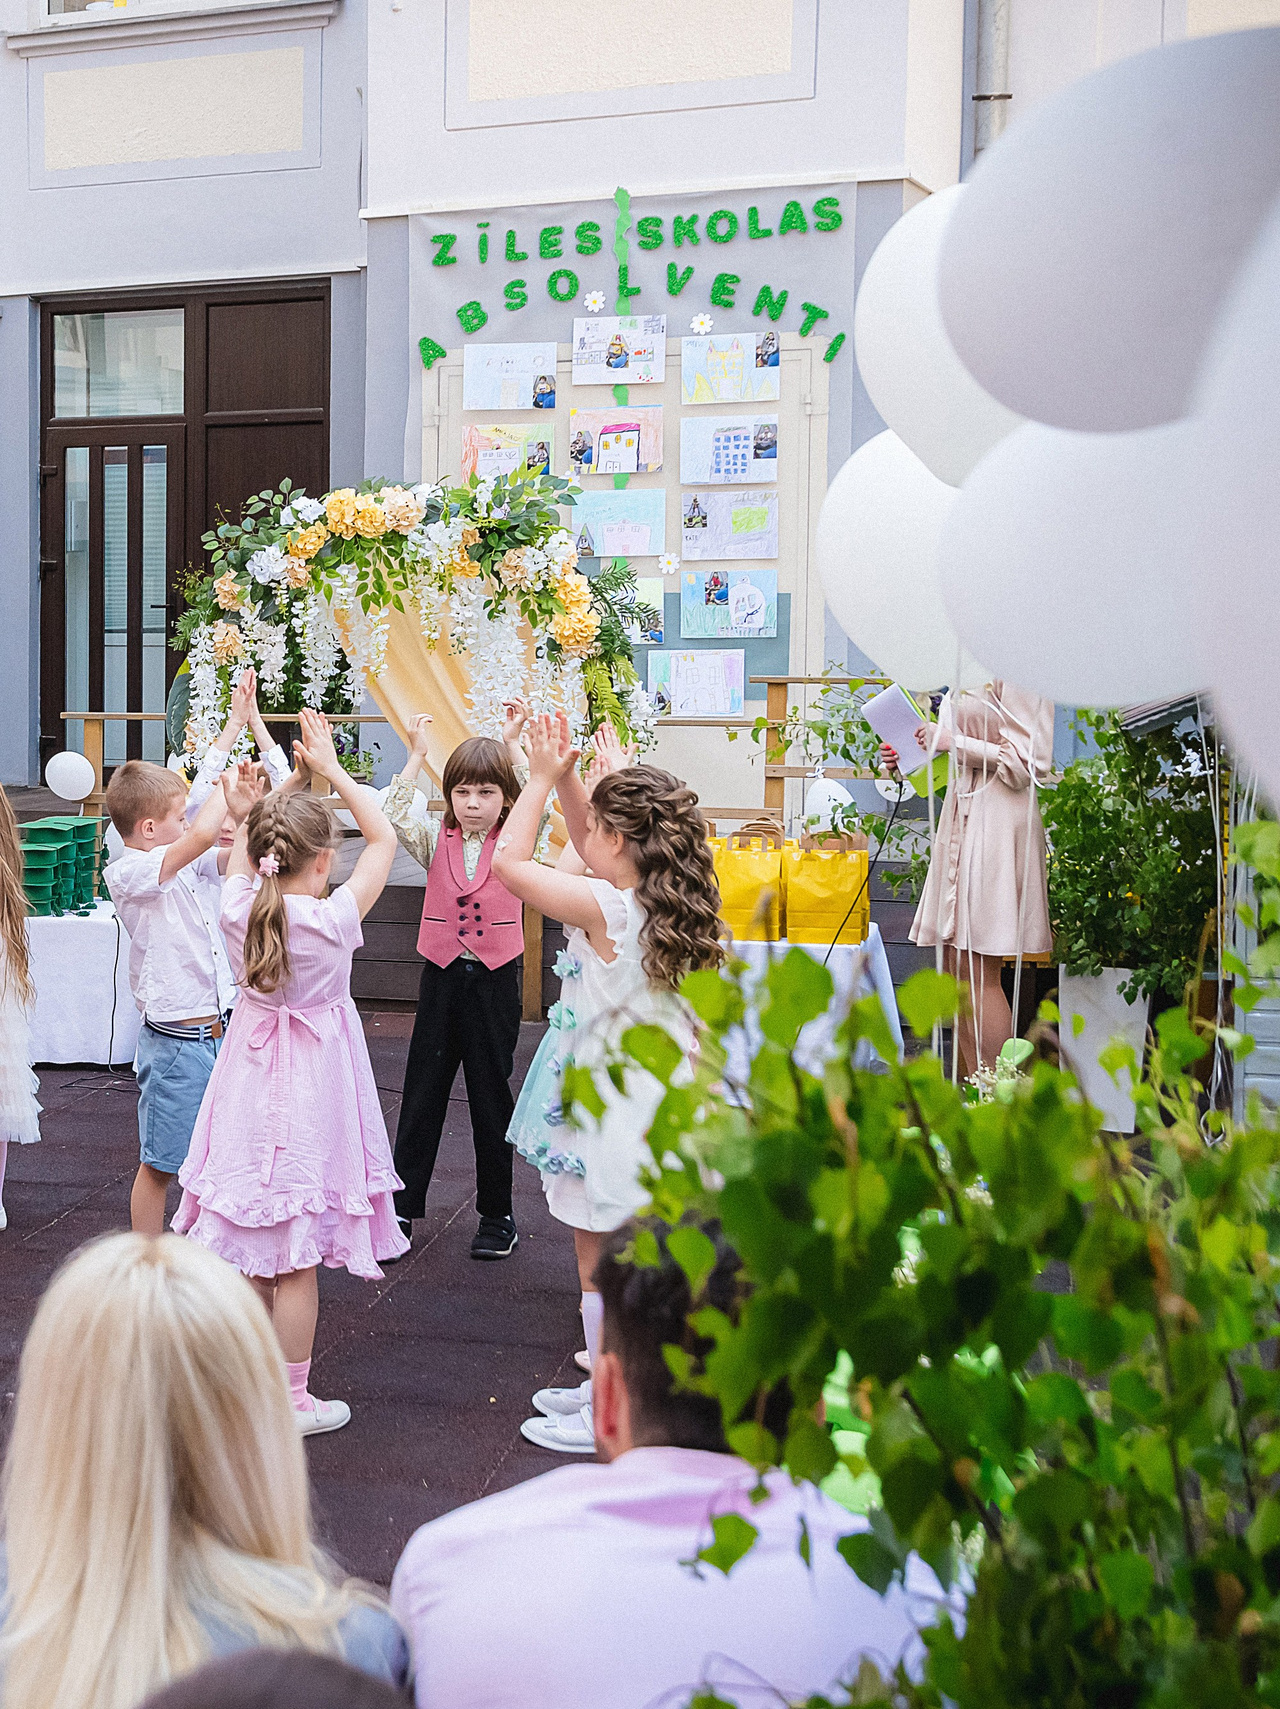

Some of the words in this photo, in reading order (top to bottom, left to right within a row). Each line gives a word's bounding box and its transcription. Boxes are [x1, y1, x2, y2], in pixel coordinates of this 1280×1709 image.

[431, 221, 602, 266] ZĪLES
[637, 197, 843, 250] SKOLAS
[419, 262, 846, 369] ABSOLVENTI
